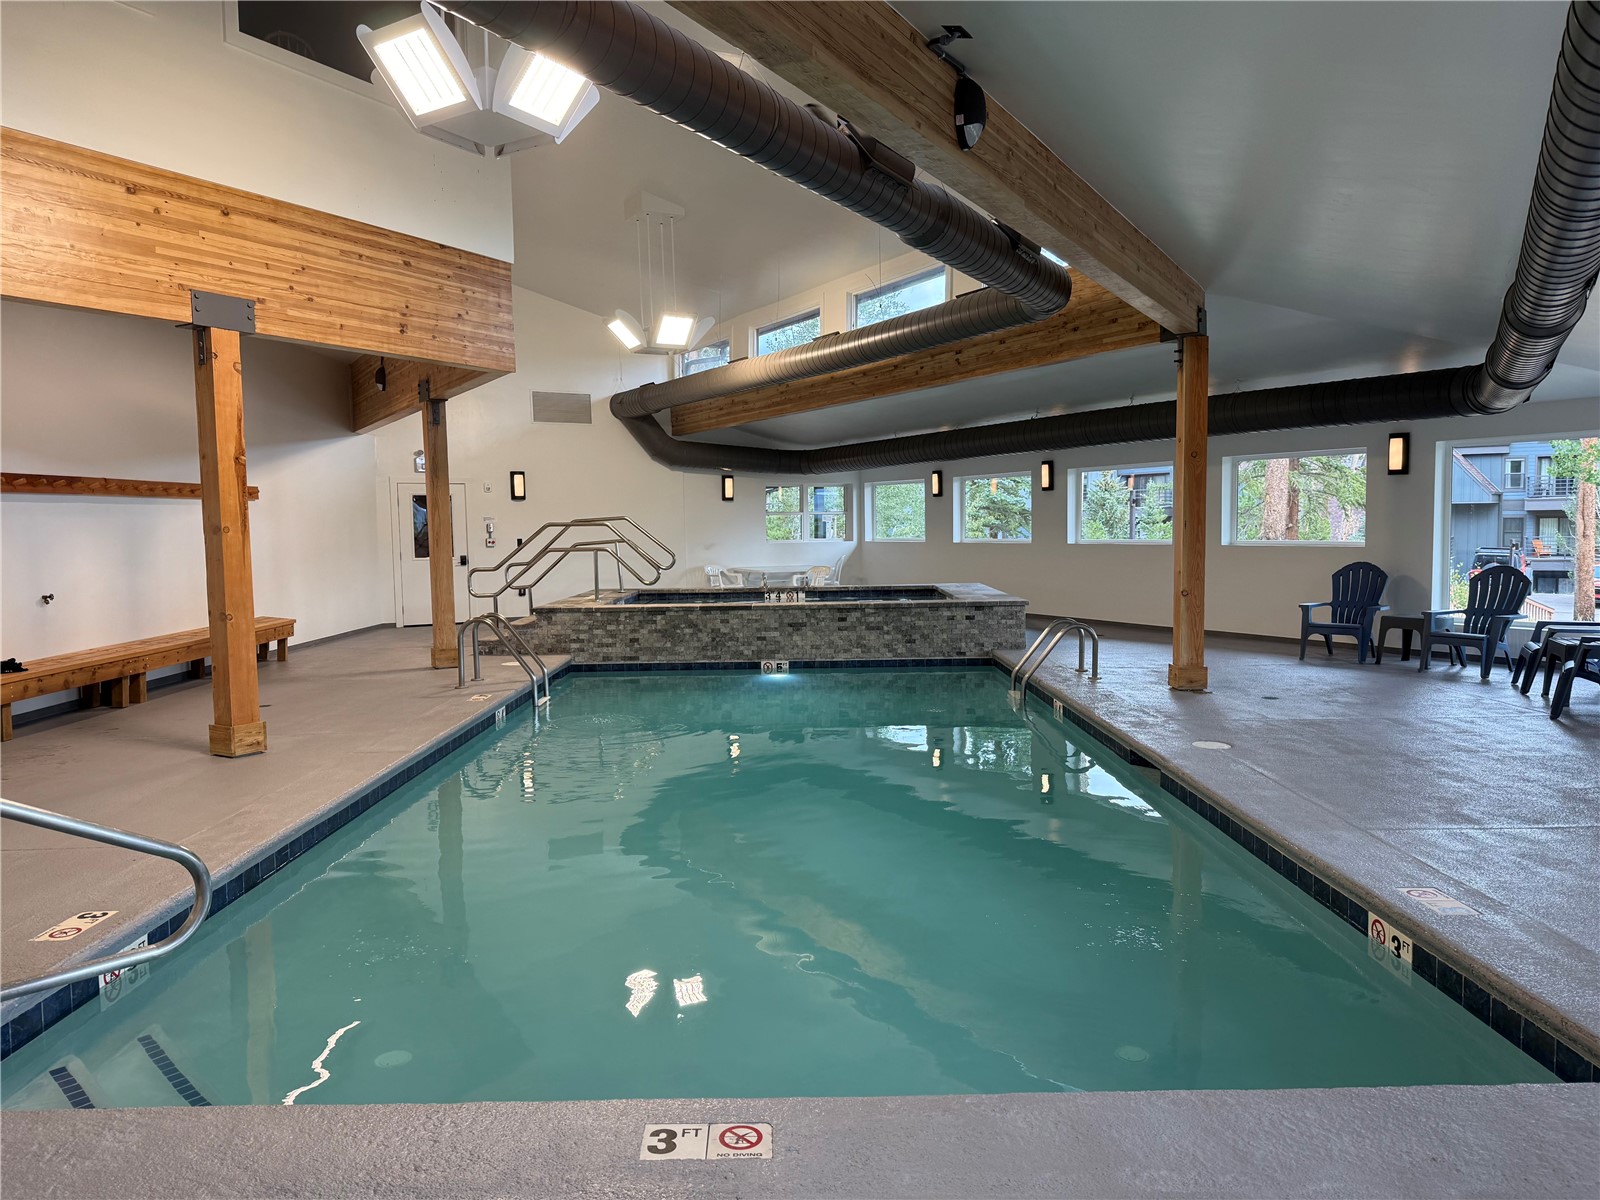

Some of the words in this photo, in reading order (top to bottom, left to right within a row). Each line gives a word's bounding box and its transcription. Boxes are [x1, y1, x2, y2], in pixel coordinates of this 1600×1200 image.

[776, 662, 783, 672] 5
[1391, 935, 1402, 959] 3
[1402, 940, 1411, 954] FT
[646, 1128, 678, 1155] 3
[681, 1128, 703, 1138] FT
